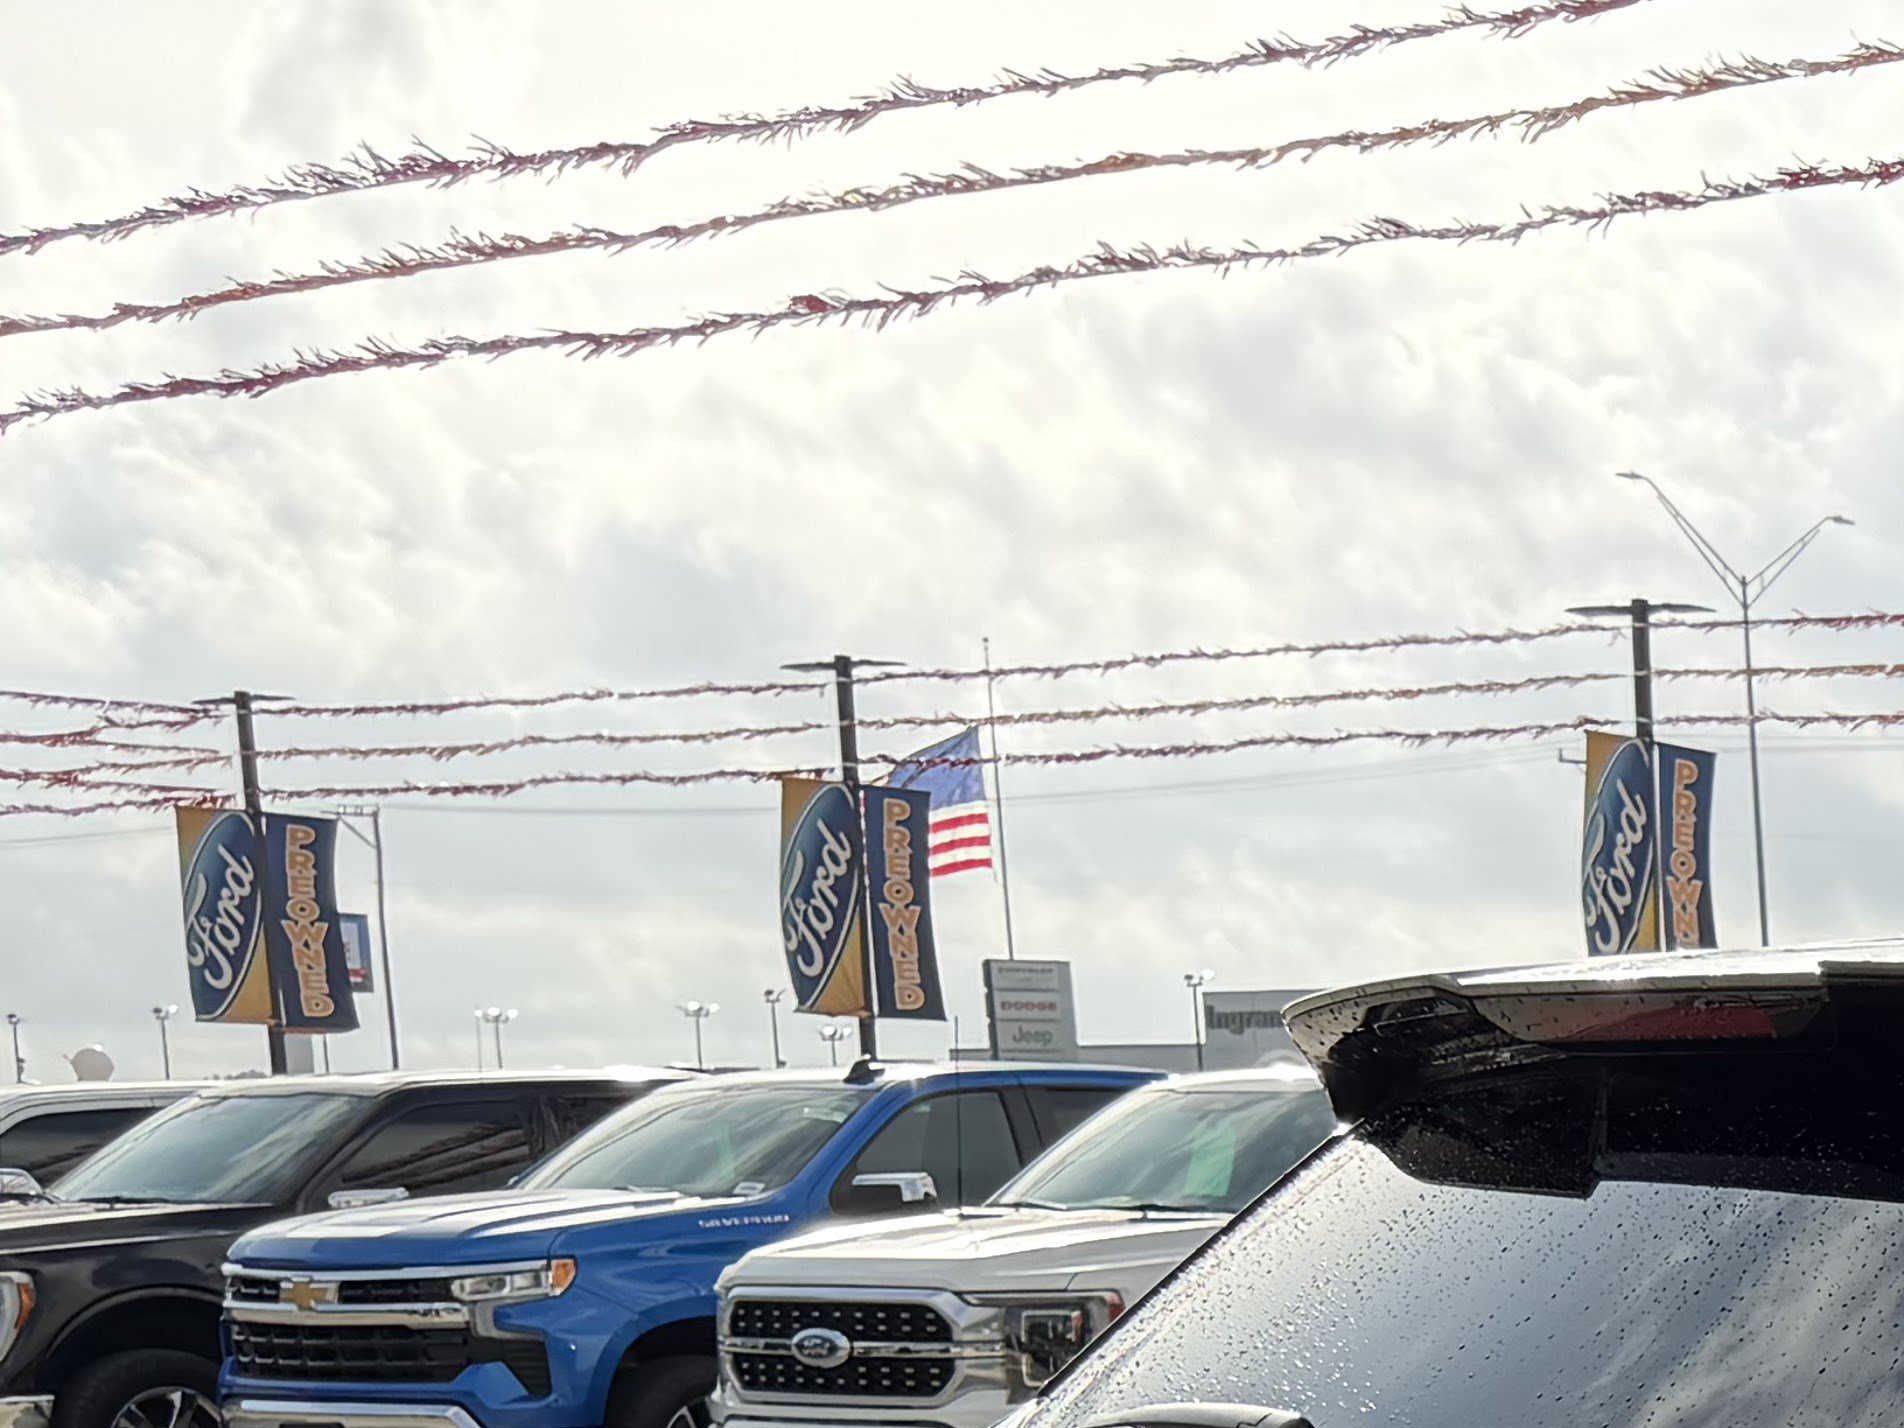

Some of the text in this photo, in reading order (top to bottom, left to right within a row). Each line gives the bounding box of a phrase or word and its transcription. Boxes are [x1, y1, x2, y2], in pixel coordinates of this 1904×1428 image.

[187, 842, 255, 990] Ford
[281, 824, 335, 1017] PREOWNED
[784, 818, 852, 978] Ford
[878, 798, 925, 1010] PREOWNED
[1583, 778, 1648, 954] Ford
[1666, 758, 1702, 947] PREOWN
[1013, 1024, 1053, 1046] Jeep
